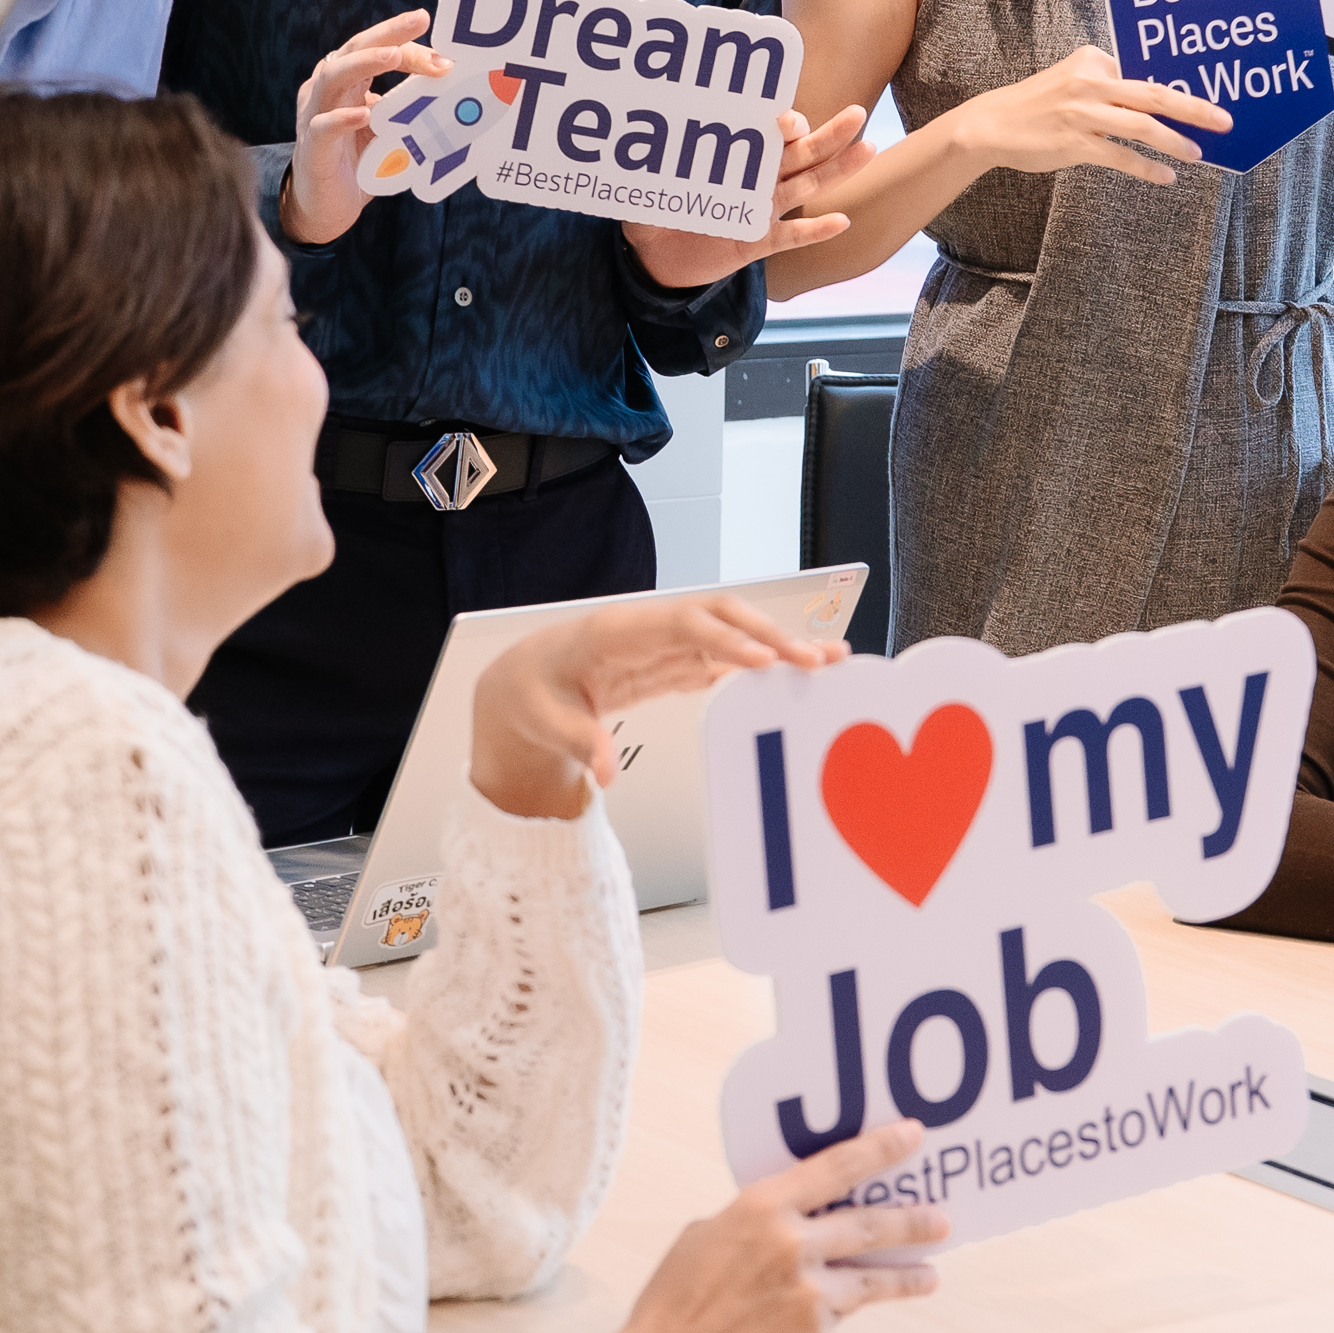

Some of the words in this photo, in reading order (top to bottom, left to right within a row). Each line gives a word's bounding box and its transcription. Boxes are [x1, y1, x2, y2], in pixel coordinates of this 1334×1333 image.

[1137, 11, 1279, 61] Places
[503, 62, 765, 191] Team
[496, 161, 754, 226] #BestPlacestoWork
[754, 729, 796, 913] I
[1022, 670, 1271, 862] my
[399, 881, 426, 893] Tiger
[776, 926, 1103, 1161] Job
[827, 1065, 1272, 1209] estPlacestoWork
